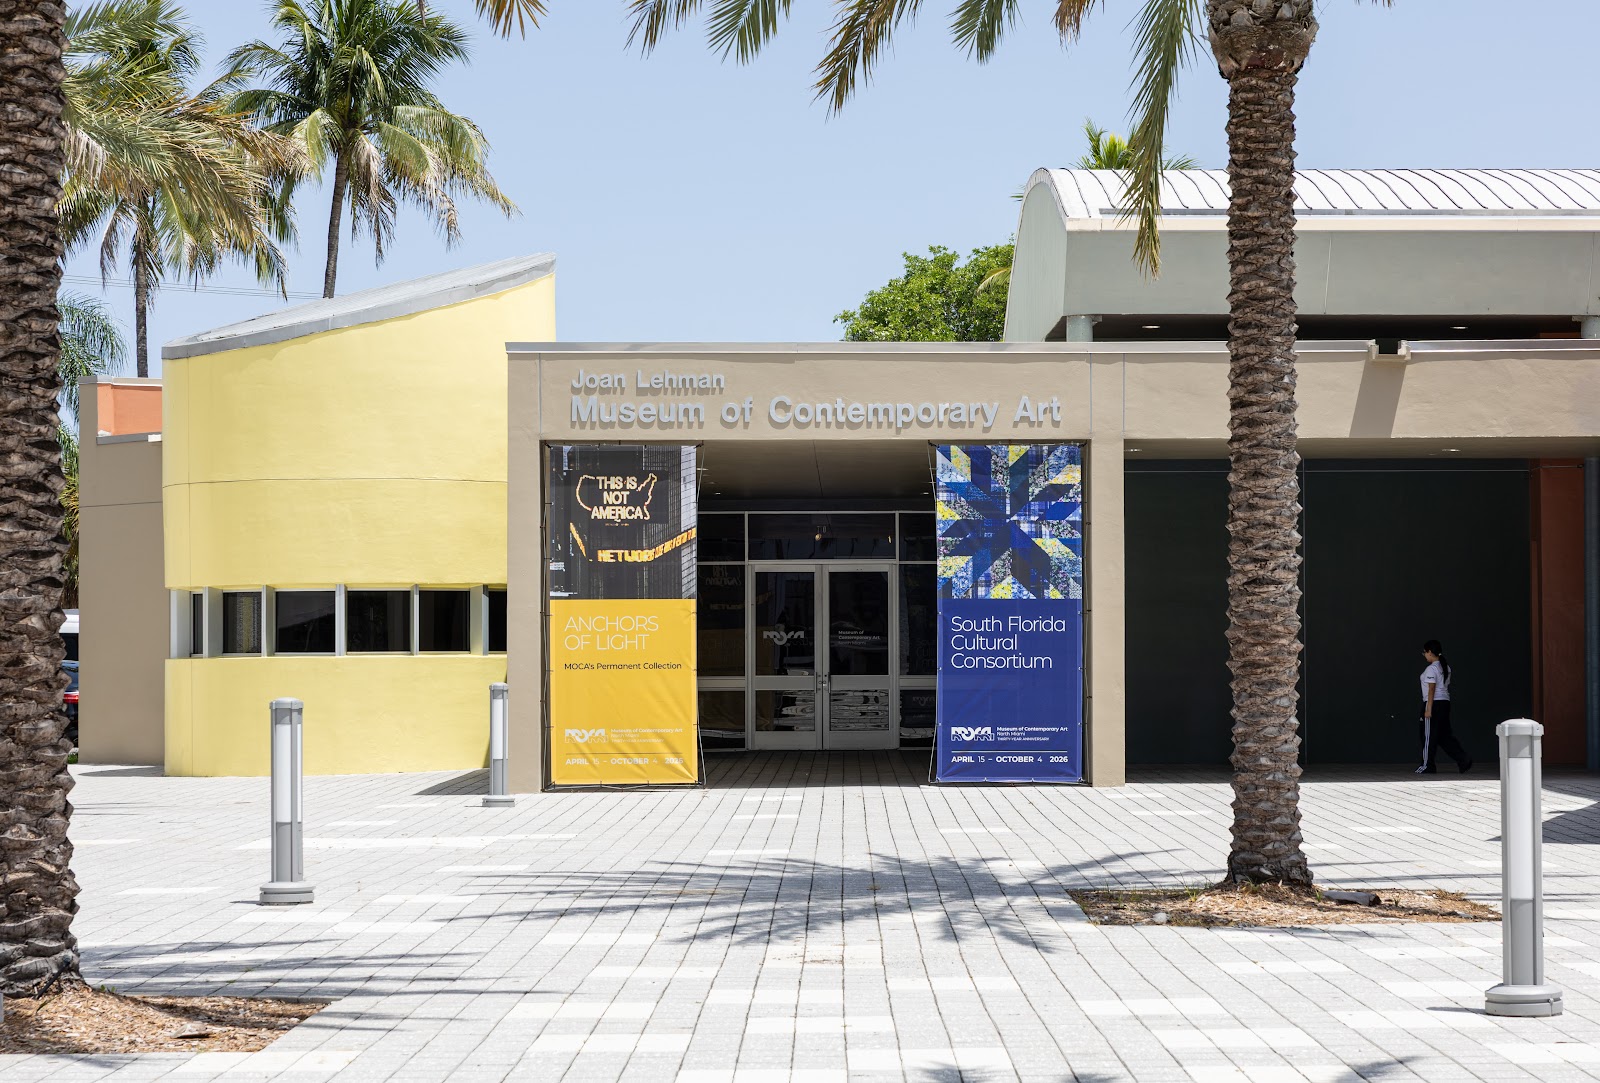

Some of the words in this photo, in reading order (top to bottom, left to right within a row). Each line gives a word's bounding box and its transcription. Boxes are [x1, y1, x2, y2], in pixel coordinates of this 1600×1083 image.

[571, 369, 626, 389] Joan
[637, 369, 725, 389] Lehman
[571, 395, 705, 423] Museum
[721, 396, 753, 423] of
[769, 395, 1000, 428] Contemporary
[1014, 395, 1062, 422] Art
[596, 476, 623, 490] THIS
[626, 476, 638, 490] IS
[603, 491, 630, 505] NOT
[591, 506, 644, 520] AMERICA
[564, 615, 659, 632] ANCHORS
[951, 615, 1003, 632] South
[1008, 615, 1066, 632] Florida
[564, 634, 592, 650] OF
[596, 634, 650, 650] LIGHT
[951, 633, 1018, 650] Cultural
[564, 662, 595, 670] MOCA's
[596, 662, 641, 670] Permanent
[643, 662, 682, 670] Collection
[951, 652, 1053, 669] Consortium
[610, 757, 649, 765] OCTOBER
